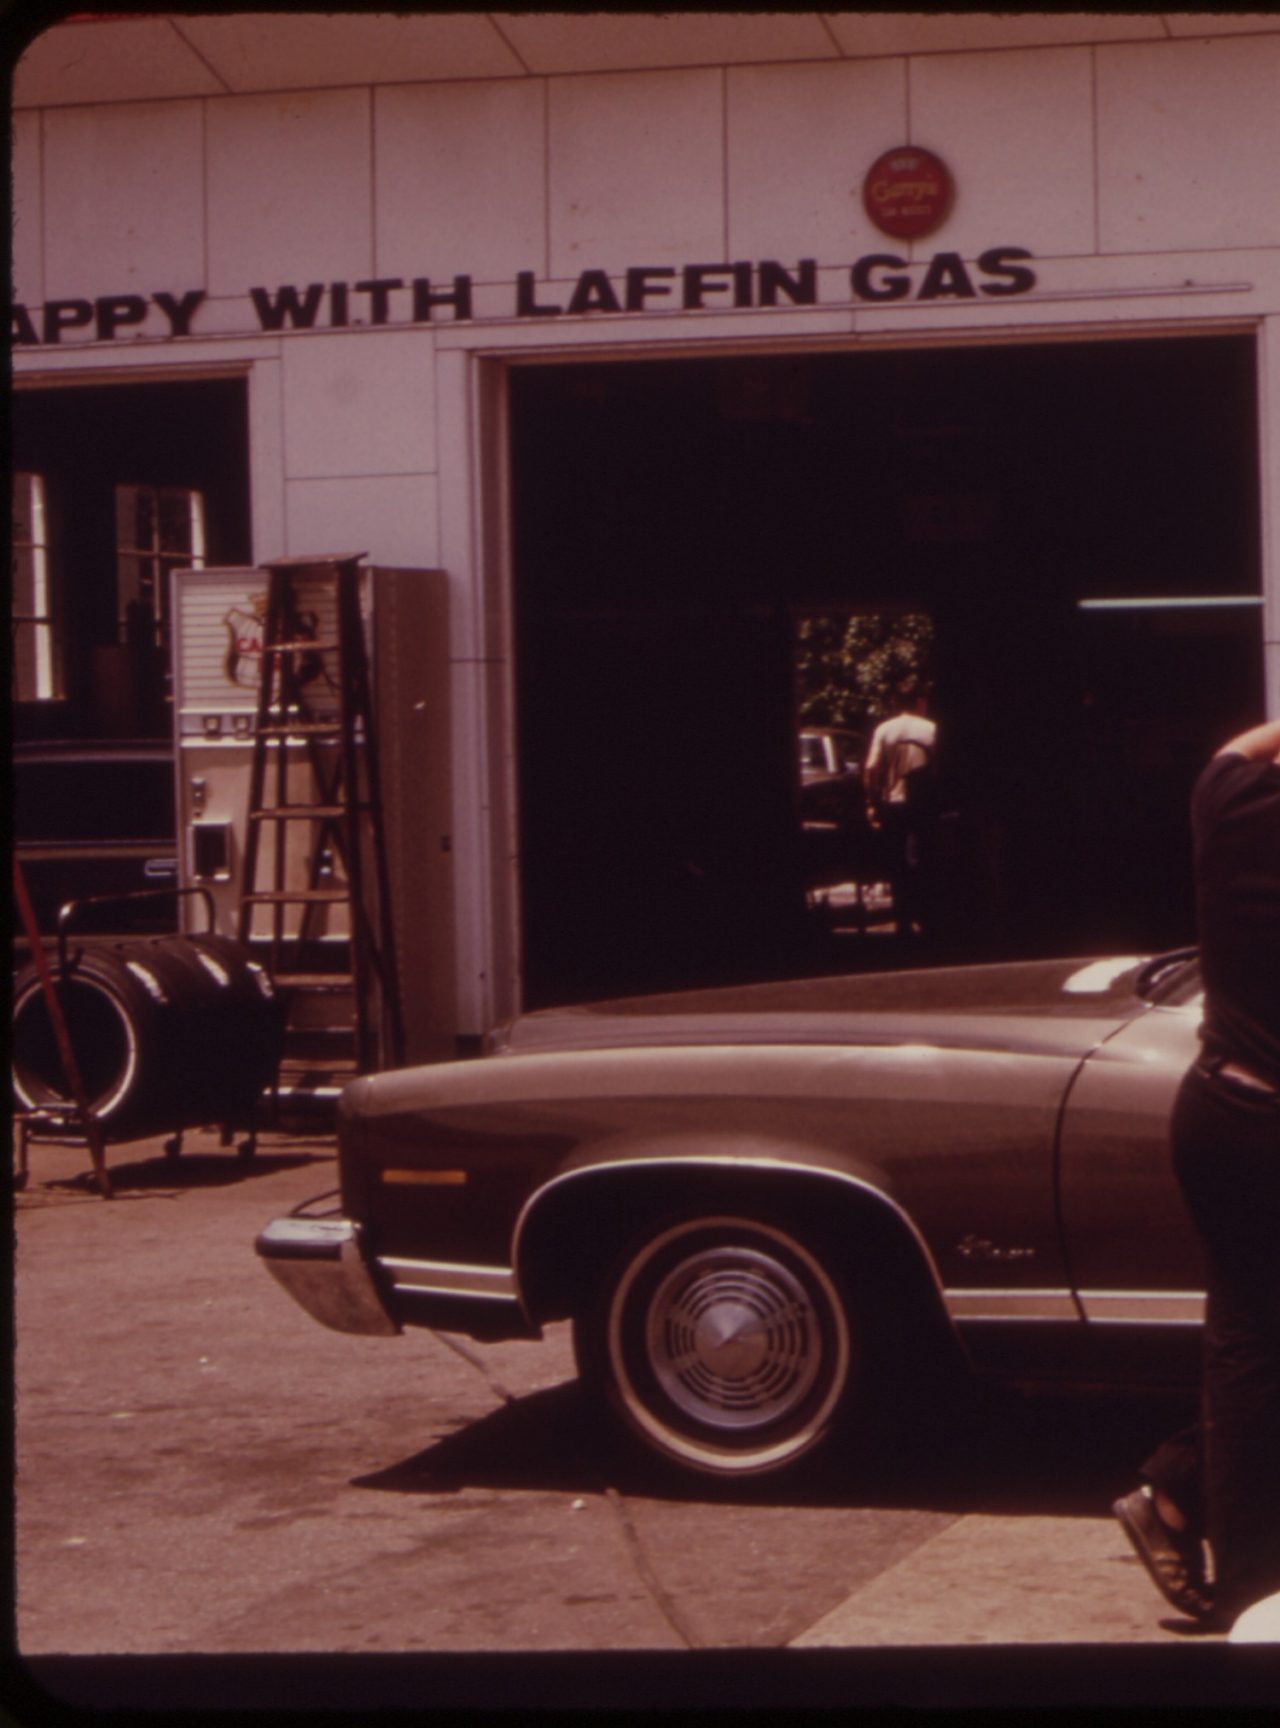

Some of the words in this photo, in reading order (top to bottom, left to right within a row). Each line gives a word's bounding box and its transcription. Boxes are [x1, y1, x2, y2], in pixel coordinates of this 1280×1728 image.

[11, 290, 206, 344] APPY
[251, 275, 472, 331] WITH
[516, 258, 818, 318] LAFFIN
[850, 247, 1037, 302] GAS
